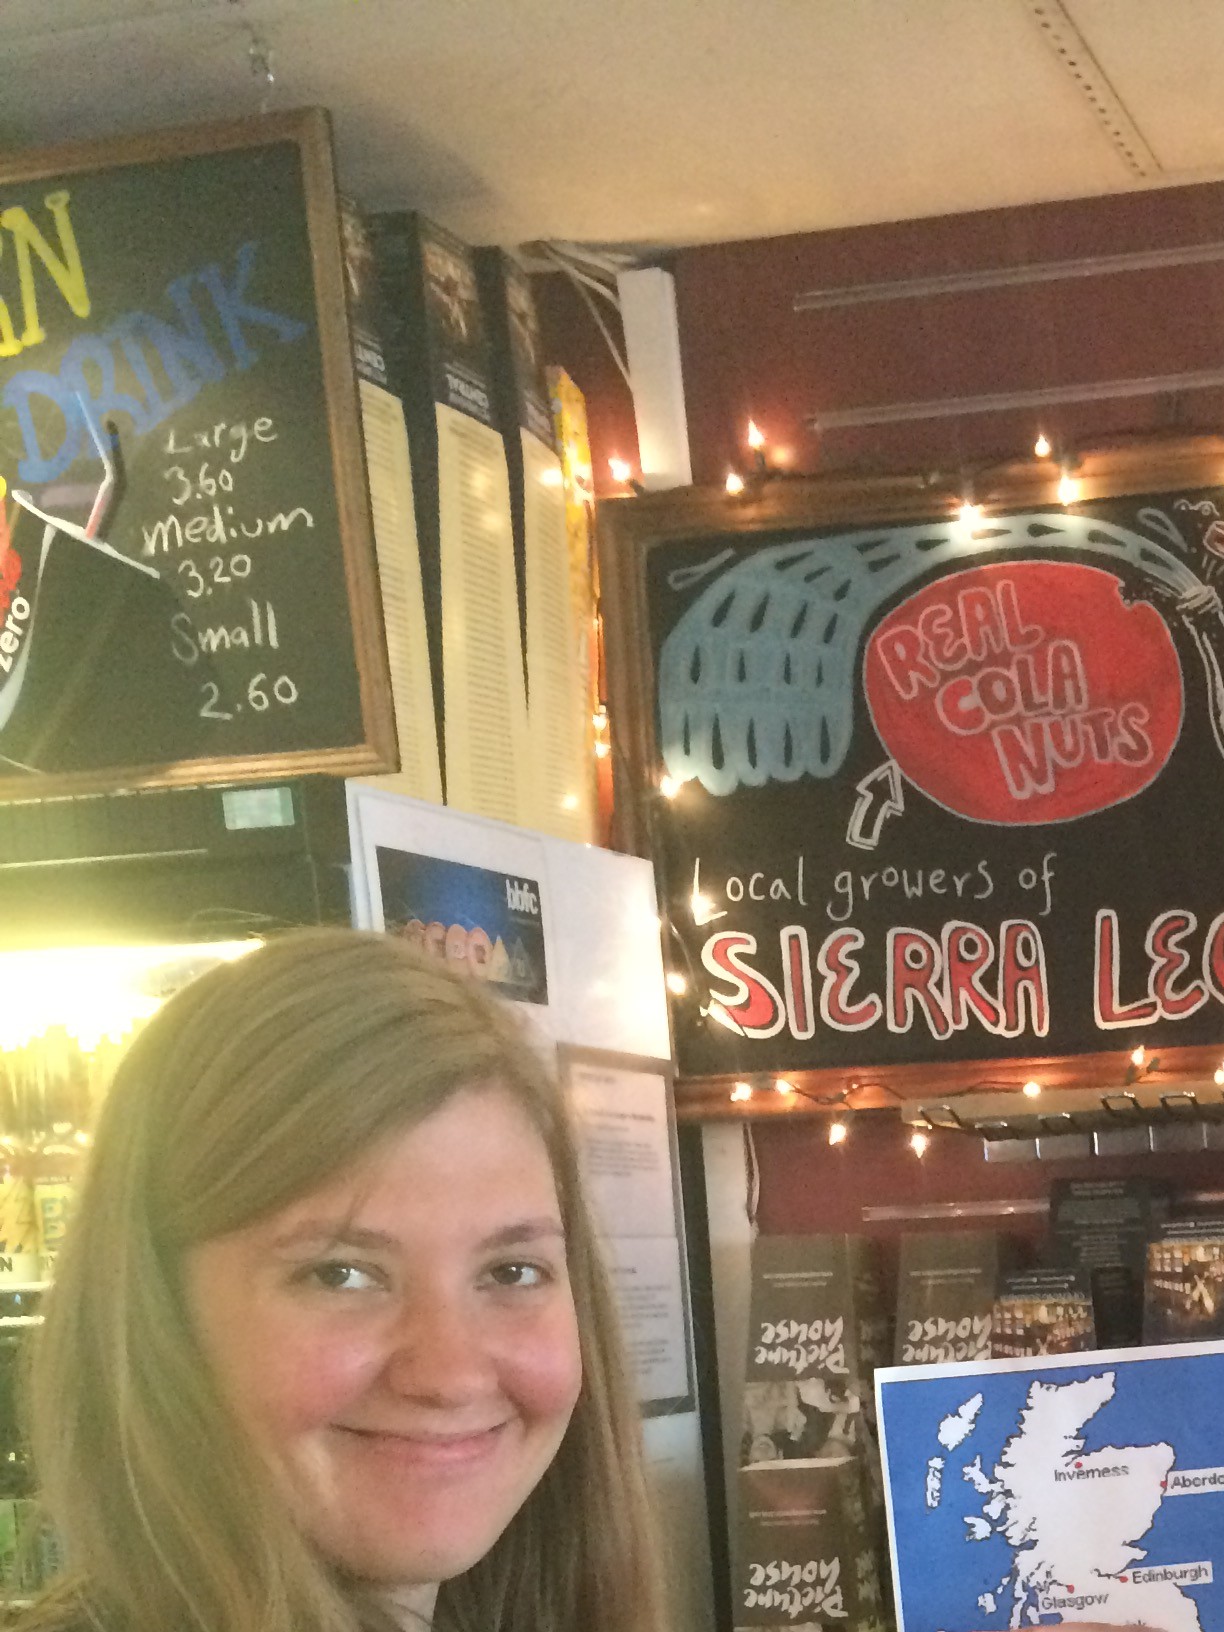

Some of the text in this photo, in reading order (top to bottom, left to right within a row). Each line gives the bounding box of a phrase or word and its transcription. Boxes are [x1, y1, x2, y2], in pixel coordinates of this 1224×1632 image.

[1, 241, 307, 483] DRINK
[165, 417, 278, 462] Large
[164, 462, 233, 505] 3.60
[178, 554, 251, 598] 3.20
[171, 598, 279, 666] Small
[876, 579, 1046, 700] REAL
[199, 673, 298, 720] 2.60
[935, 639, 1088, 736] COLA
[991, 702, 1154, 799] NUTS
[505, 878, 539, 915] bbfc
[690, 852, 1057, 926] Local growers of
[700, 919, 1050, 1040] SIERRA
[1054, 1464, 1130, 1482] Inverness
[749, 1556, 841, 1594] house
[1132, 1565, 1209, 1584] Edinburgh
[1041, 1594, 1109, 1612] Glasgow
